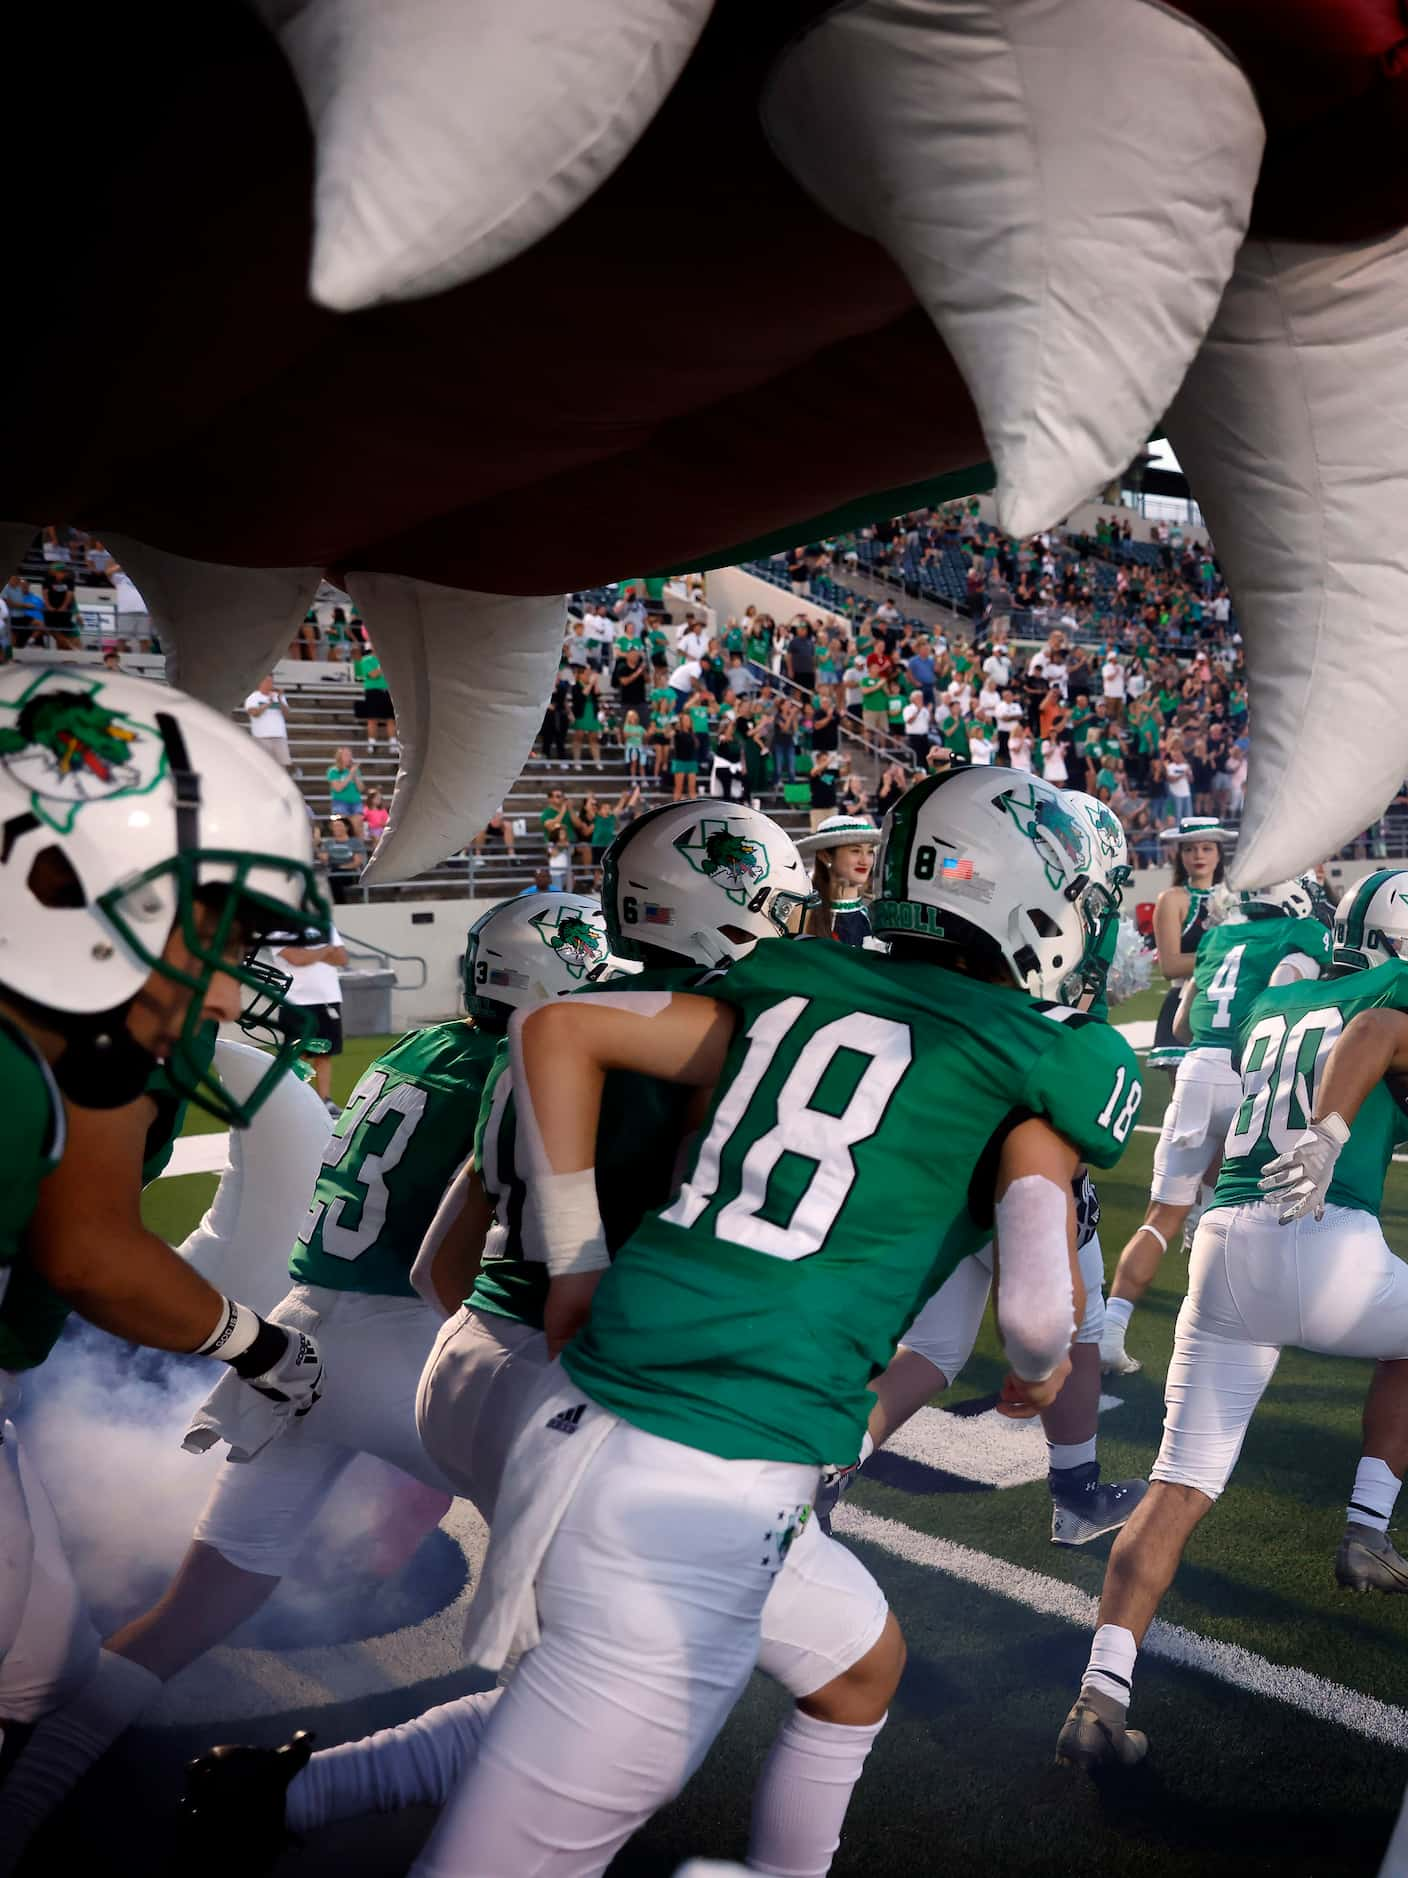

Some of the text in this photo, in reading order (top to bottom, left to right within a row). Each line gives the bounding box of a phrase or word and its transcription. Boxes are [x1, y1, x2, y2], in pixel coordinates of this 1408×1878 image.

[914, 845, 937, 880] 8
[623, 896, 638, 925] 6
[475, 961, 488, 985] 3
[1207, 944, 1246, 1028] 4
[1098, 1064, 1143, 1143] 18
[1225, 1006, 1346, 1158] 80
[658, 996, 913, 1261] 18
[215, 1328, 233, 1347] GOD
